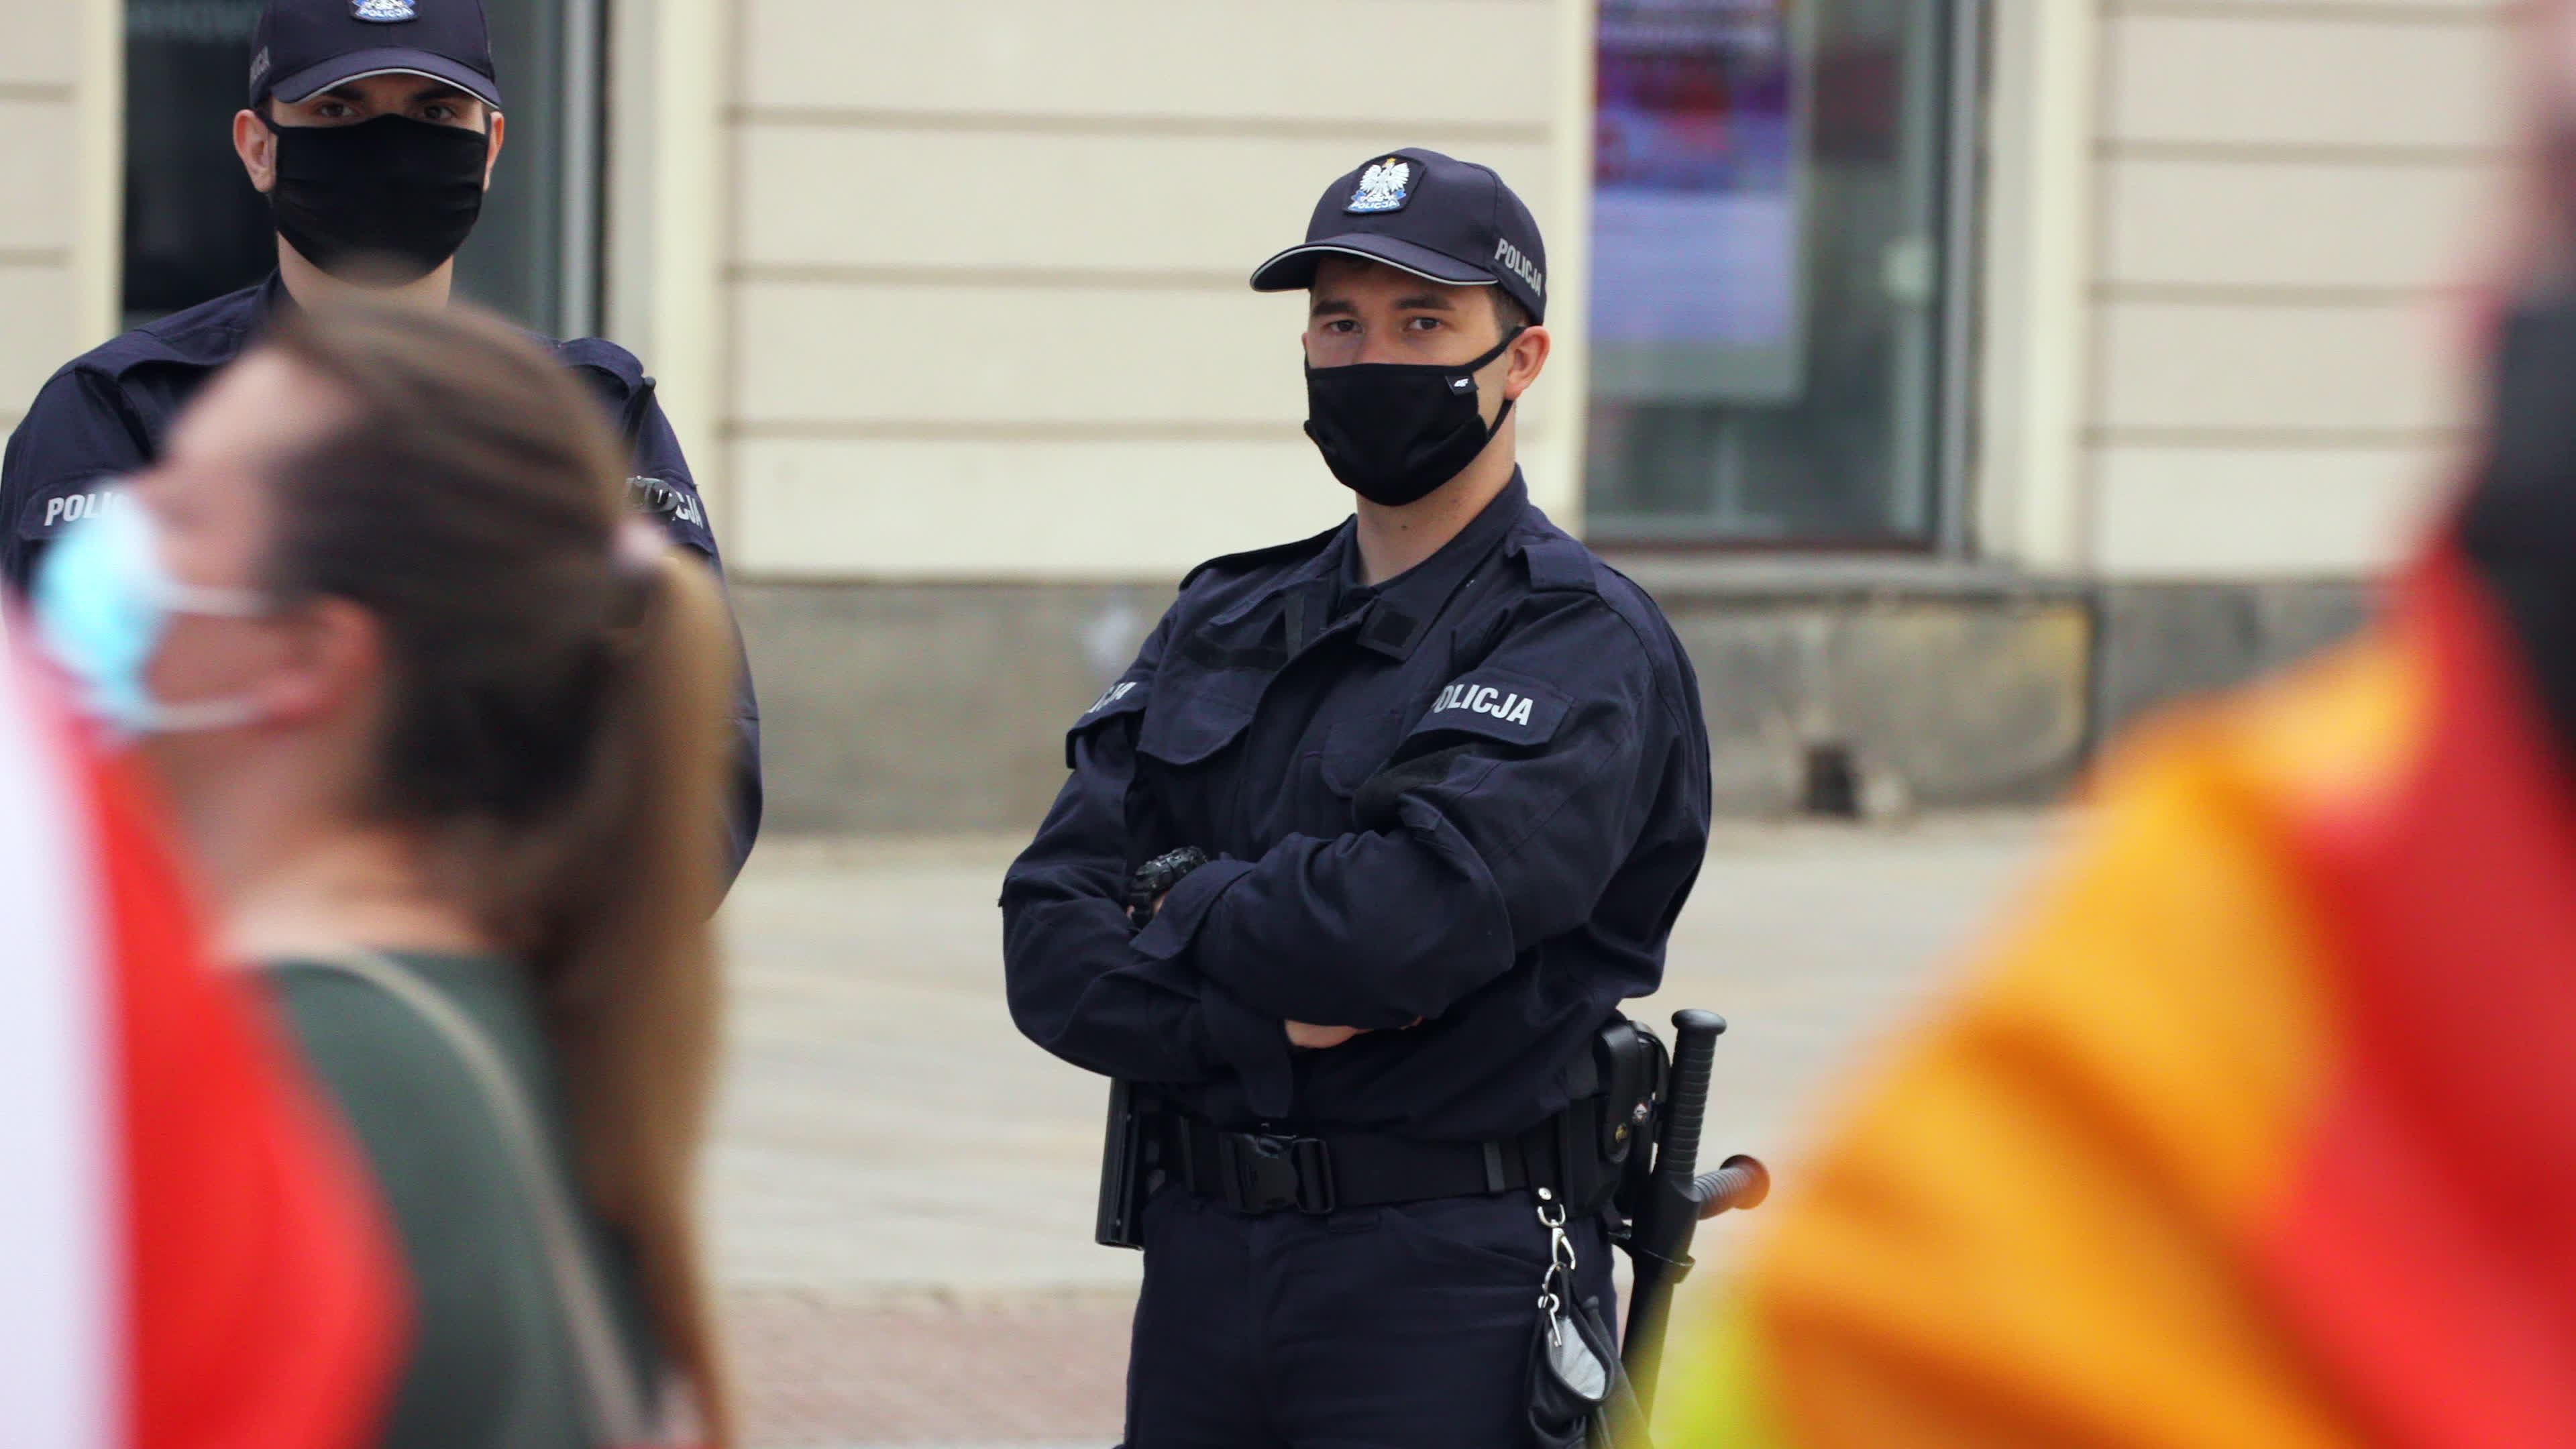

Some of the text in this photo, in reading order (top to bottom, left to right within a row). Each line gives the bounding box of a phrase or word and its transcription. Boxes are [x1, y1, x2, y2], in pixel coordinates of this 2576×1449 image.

[1350, 200, 1397, 209] POLICJA
[1495, 237, 1542, 297] POLICJA
[1432, 684, 1534, 726] OLICJA
